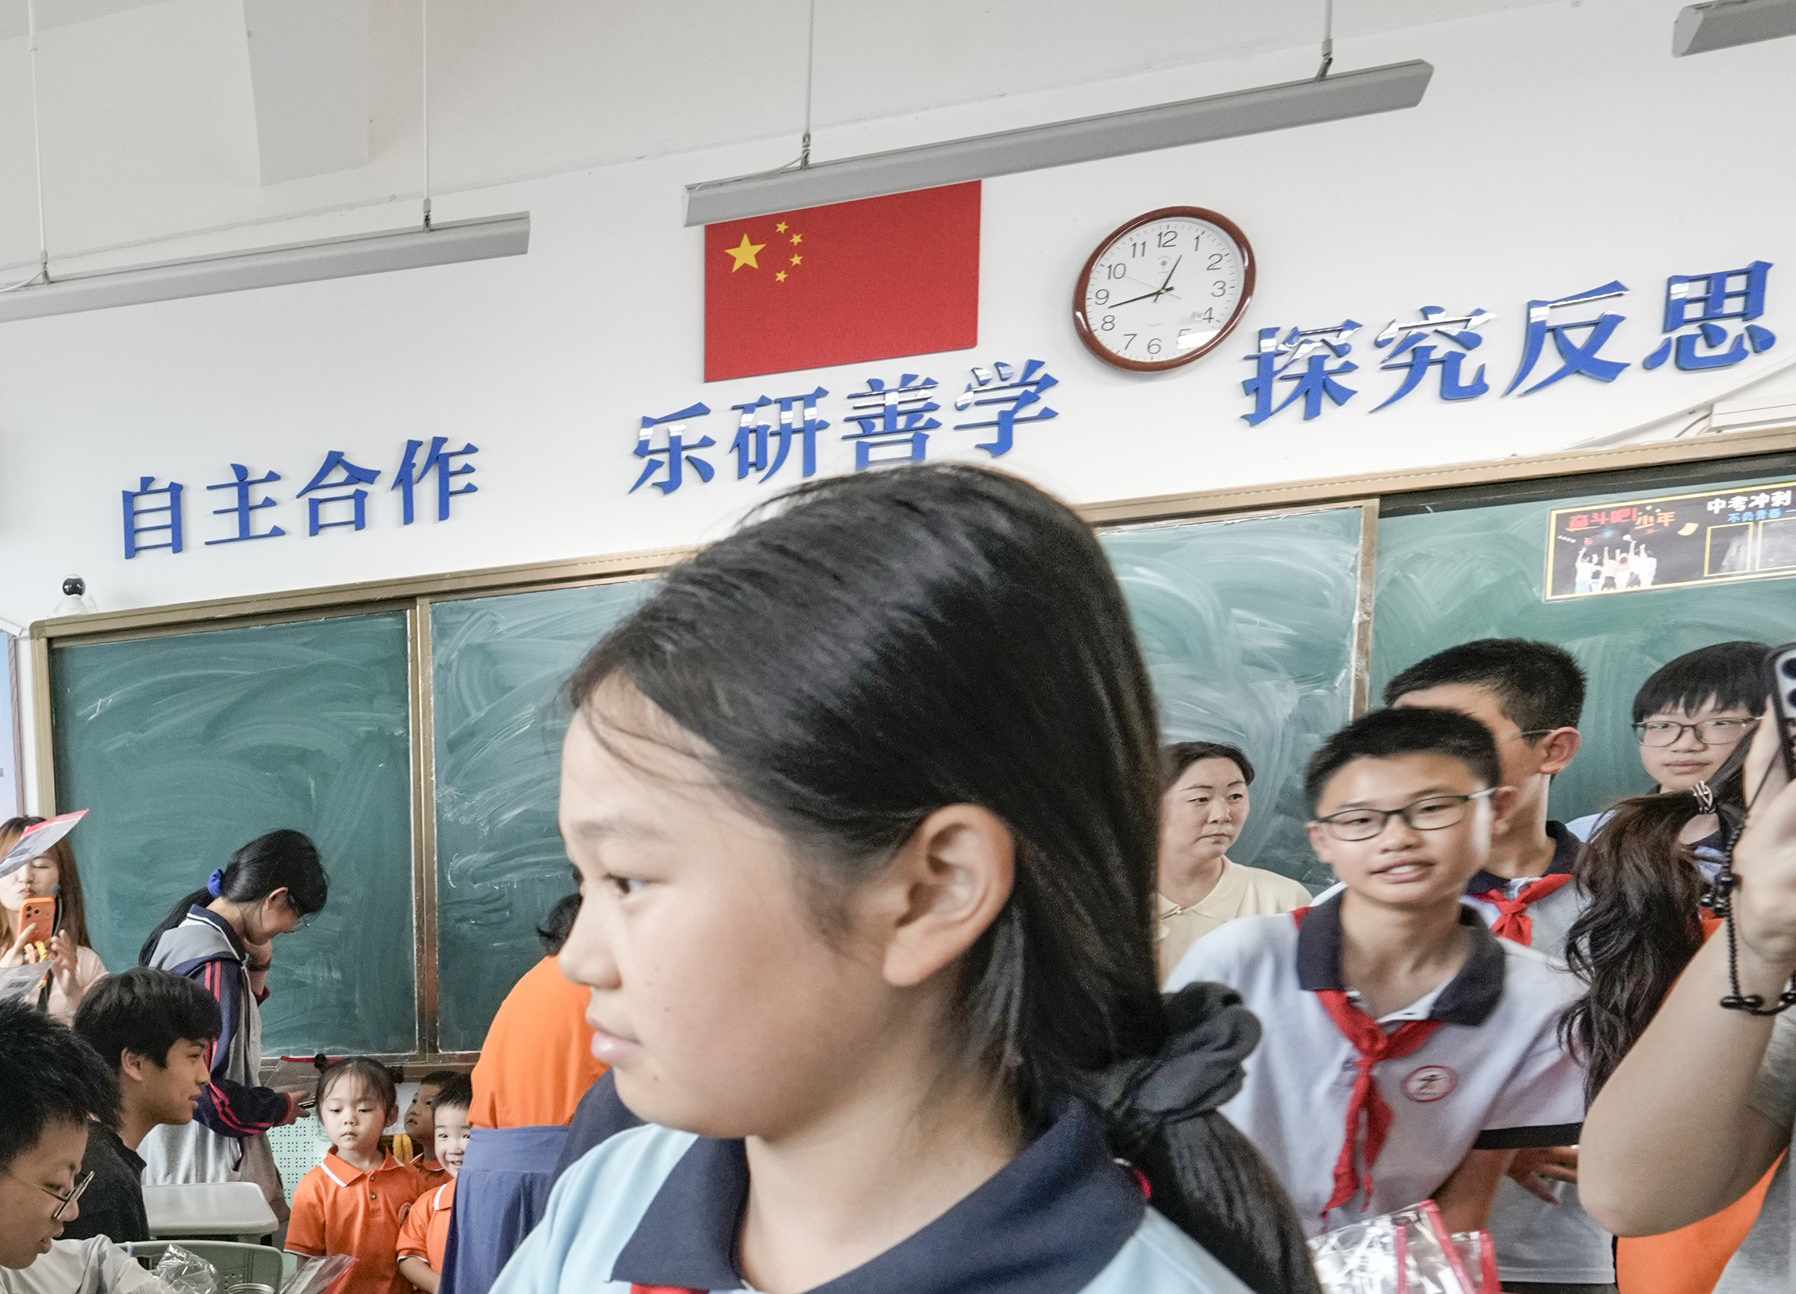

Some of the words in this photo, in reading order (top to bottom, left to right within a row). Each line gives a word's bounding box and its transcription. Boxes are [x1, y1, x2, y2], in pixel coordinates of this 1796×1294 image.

[1156, 230, 1178, 248] 12
[1194, 235, 1201, 251] 1
[1132, 241, 1146, 258] 11
[1206, 253, 1223, 270] 2
[1107, 263, 1127, 280] 10
[1094, 288, 1109, 305] 9
[1211, 280, 1226, 297] 3
[1101, 315, 1116, 331] 8
[1202, 307, 1214, 323] 4
[1123, 333, 1137, 350] 7
[1147, 338, 1162, 354] 6
[1240, 260, 1777, 427] 探究反思
[628, 359, 1059, 494] 乐研善学
[122, 436, 479, 559] 自主合作
[1706, 490, 1792, 514] 中考冲刺
